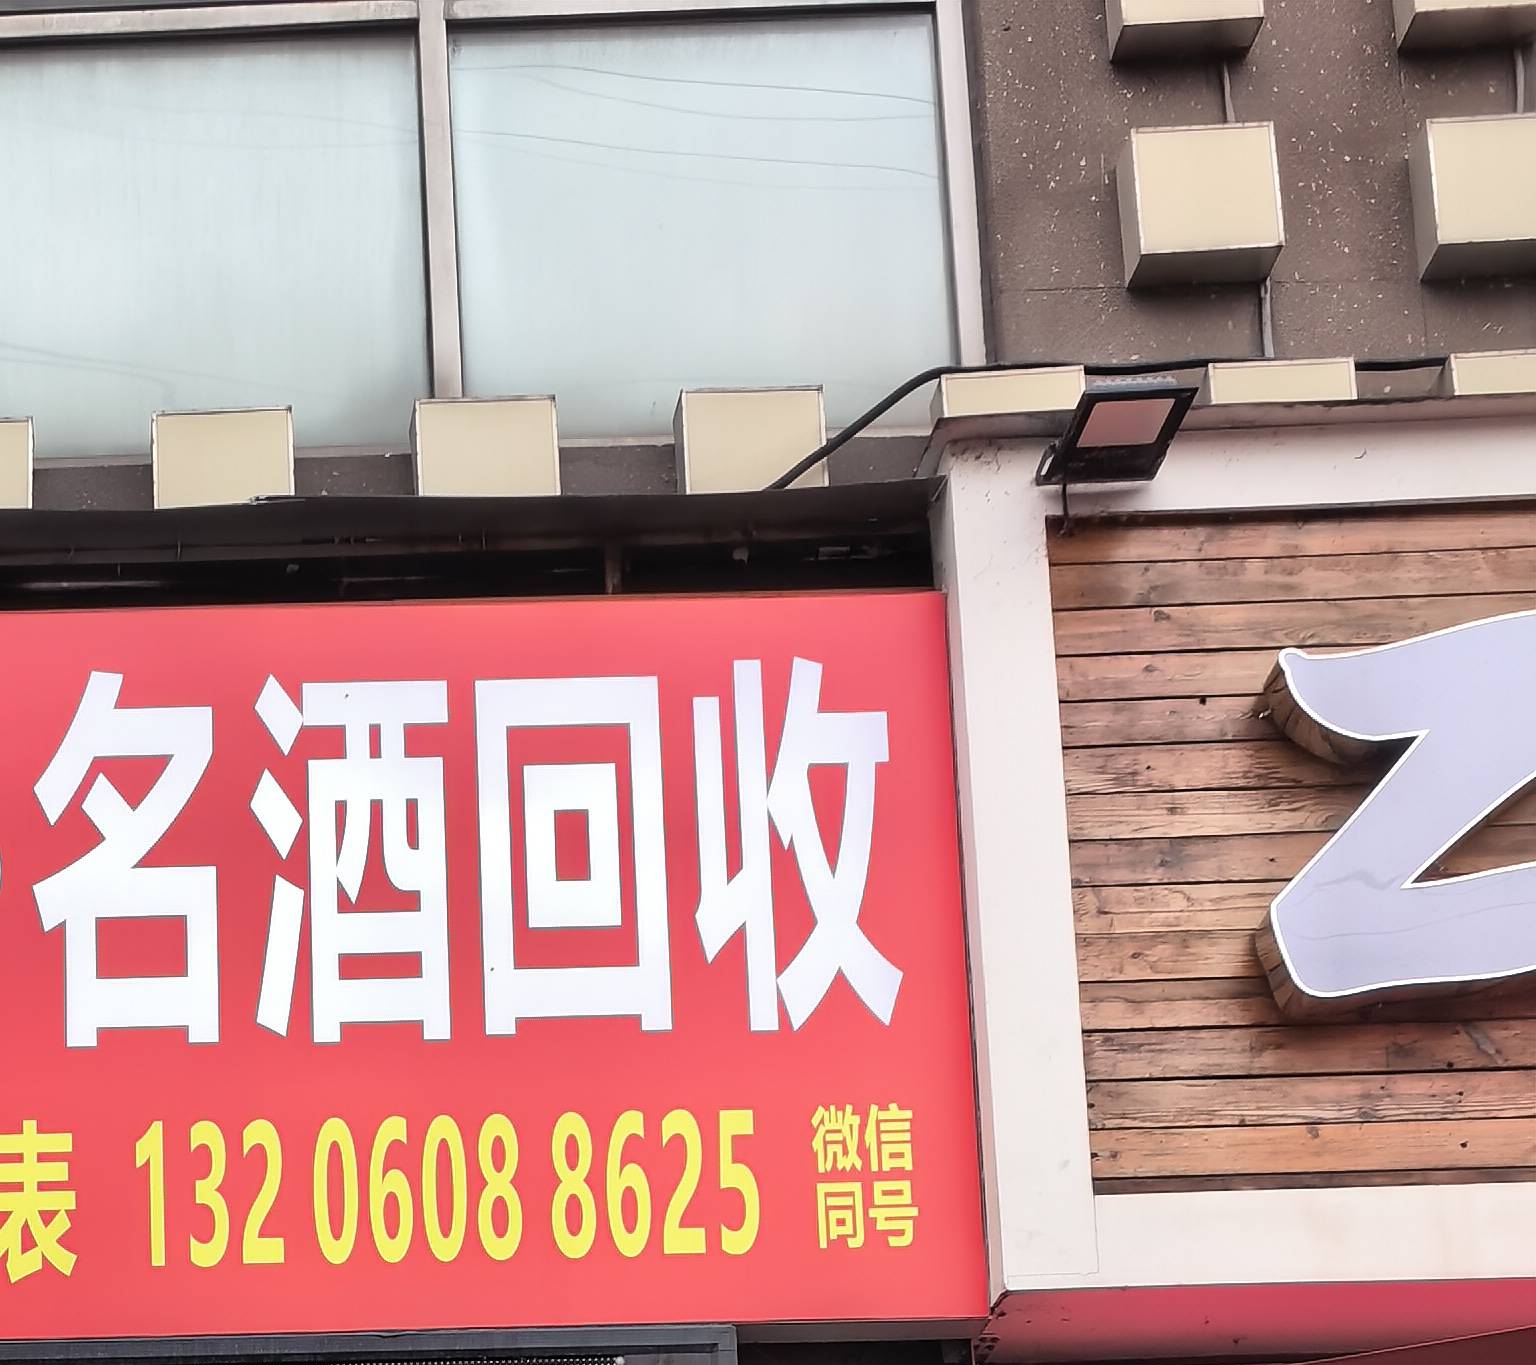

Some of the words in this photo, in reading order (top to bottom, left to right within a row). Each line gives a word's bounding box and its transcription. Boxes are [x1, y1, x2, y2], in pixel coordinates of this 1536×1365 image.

[812, 1103, 914, 1173] 微信
[135, 1117, 285, 1266] 132
[314, 1112, 521, 1264] 0608
[552, 1108, 761, 1259] 8625
[818, 1181, 919, 1249] 同号
